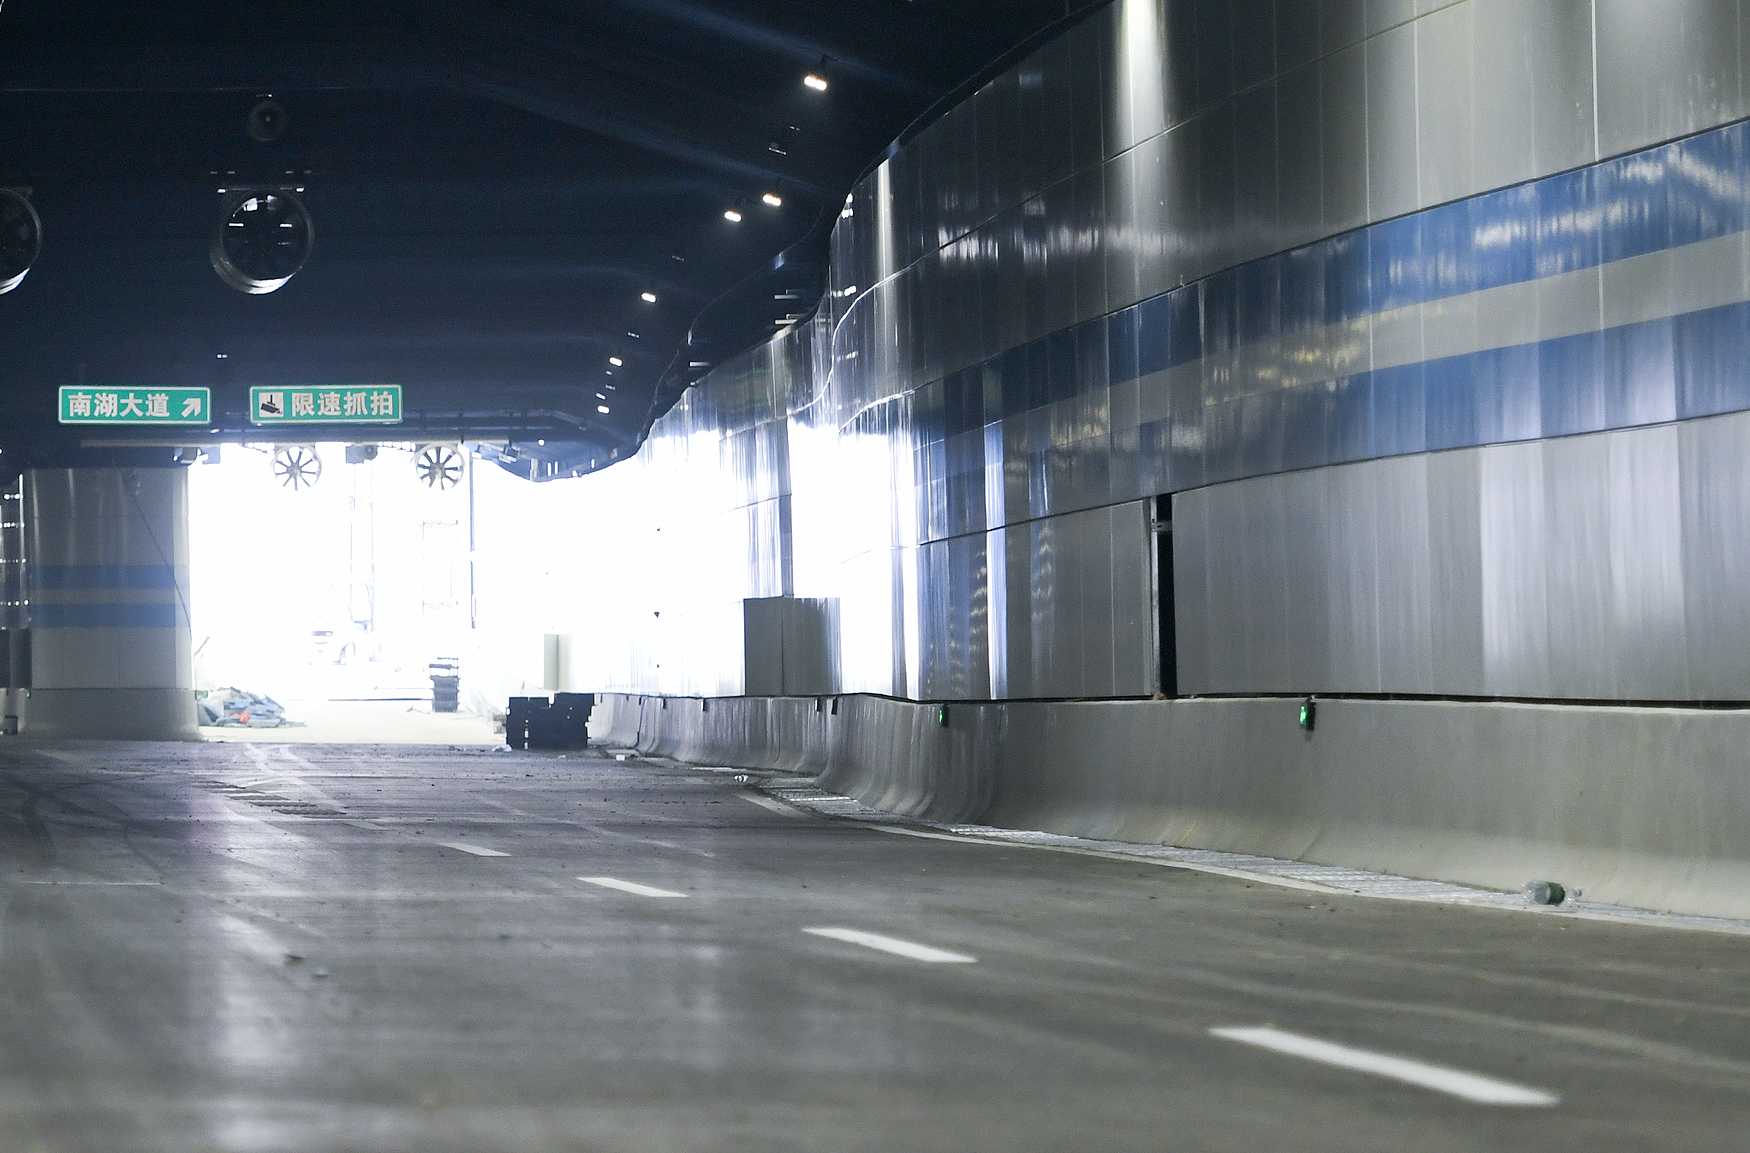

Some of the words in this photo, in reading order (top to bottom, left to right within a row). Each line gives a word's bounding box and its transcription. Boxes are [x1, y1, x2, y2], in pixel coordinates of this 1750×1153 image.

[68, 392, 170, 417] 南湖大道
[291, 391, 394, 417] 限速抓拍
